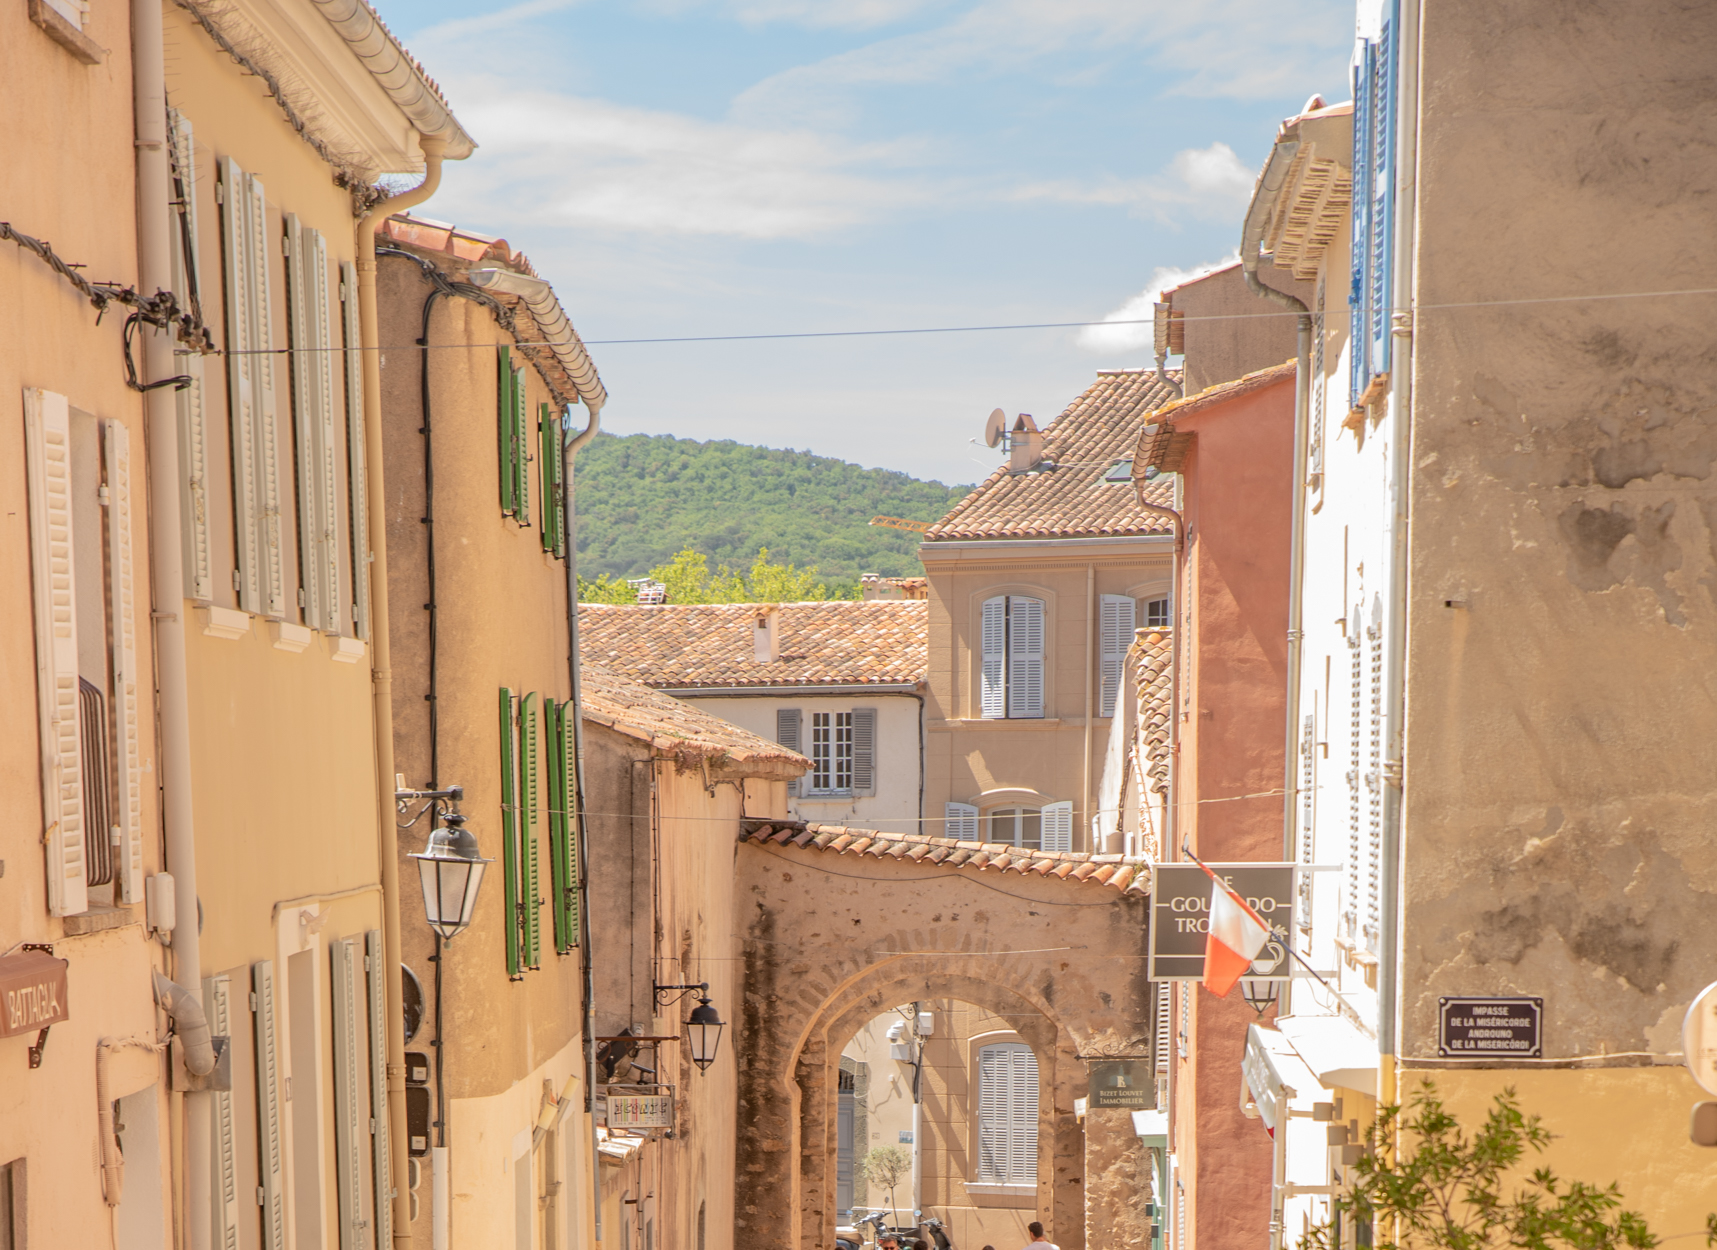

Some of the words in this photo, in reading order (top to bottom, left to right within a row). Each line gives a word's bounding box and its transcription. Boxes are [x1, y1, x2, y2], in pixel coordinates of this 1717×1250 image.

[8, 981, 60, 1029] BATTAGLIA
[1472, 1006, 1509, 1016] IMPASSE
[1450, 1017, 1462, 1027] DE
[1463, 1017, 1474, 1027] LA
[1476, 1016, 1531, 1027] MISÉRICORDE
[1467, 1028, 1513, 1039] ANDROUNO
[1451, 1039, 1463, 1049] DE
[1464, 1039, 1476, 1049] LA
